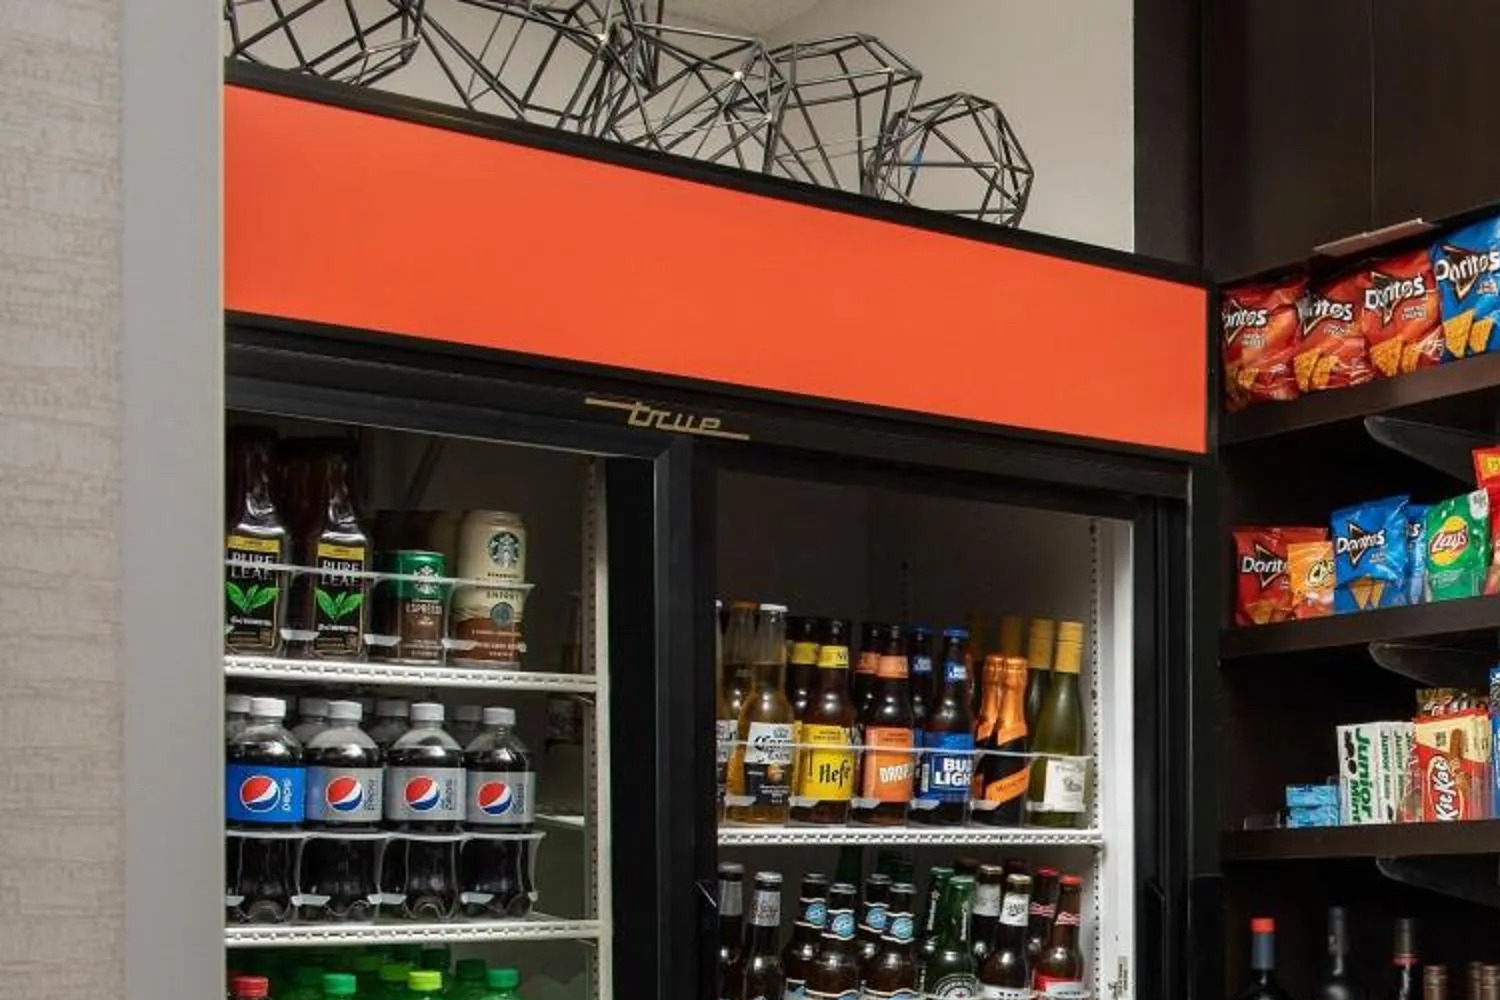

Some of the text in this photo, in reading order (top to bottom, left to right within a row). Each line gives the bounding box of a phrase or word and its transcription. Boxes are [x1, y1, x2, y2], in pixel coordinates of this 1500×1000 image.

[1364, 274, 1426, 310] Doritos
[1336, 529, 1386, 553] Doritos
[935, 771, 972, 787] LIGH
